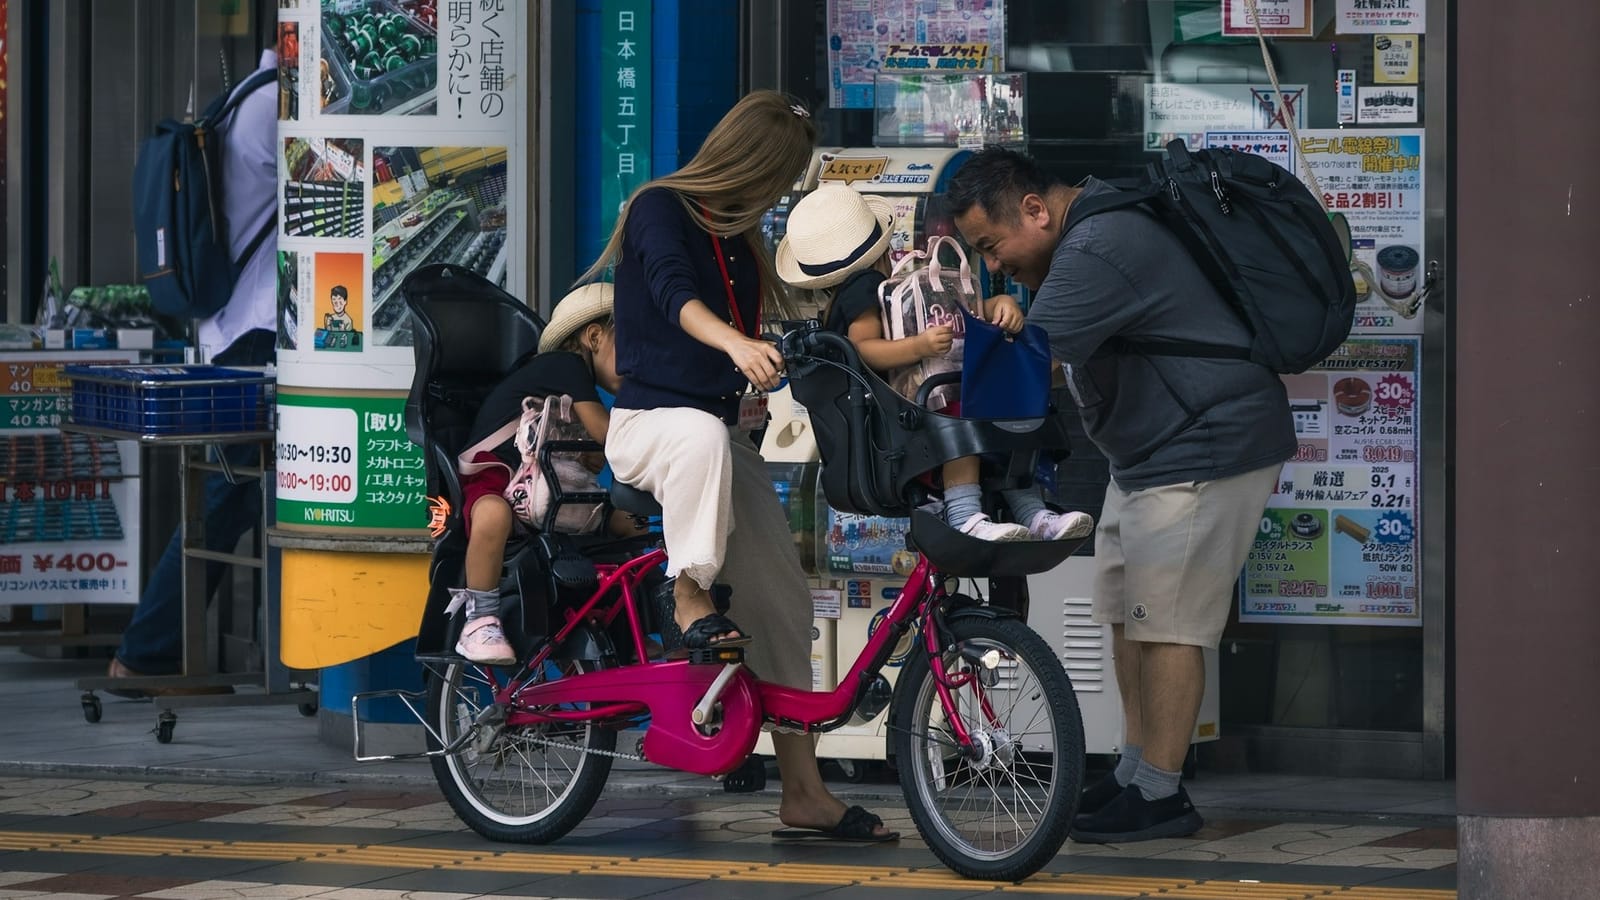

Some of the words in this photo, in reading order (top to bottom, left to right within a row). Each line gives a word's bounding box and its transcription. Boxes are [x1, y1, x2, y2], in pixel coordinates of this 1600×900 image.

[449, 2, 472, 119] 明らかに！
[617, 11, 636, 174] 日本橋五丁目
[1301, 137, 1400, 154] ビニル電線祭り
[824, 162, 882, 177] 人気です！
[1323, 192, 1403, 208] 全品2割引！
[1353, 317, 1393, 327] ンハウス
[1379, 383, 1410, 399] 30%
[1359, 416, 1412, 425] ネットワーク用
[1335, 426, 1376, 435] 空芯コイル
[1380, 426, 1412, 435] 0.68mH
[366, 438, 418, 453] クラフトオ
[366, 456, 425, 471] メカトロニク
[1313, 471, 1345, 487] 厳選
[1371, 475, 1395, 488] 9.1
[1295, 490, 1369, 501] 海外輸入品フェア
[1371, 494, 1404, 508] 9.21
[304, 508, 355, 522] KYOHRITSU
[1260, 517, 1282, 534] 0%
[1379, 519, 1411, 535] 30%
[1361, 543, 1412, 552] メタルクラッド
[1283, 563, 1295, 571] 2A
[1379, 564, 1397, 572] 50W
